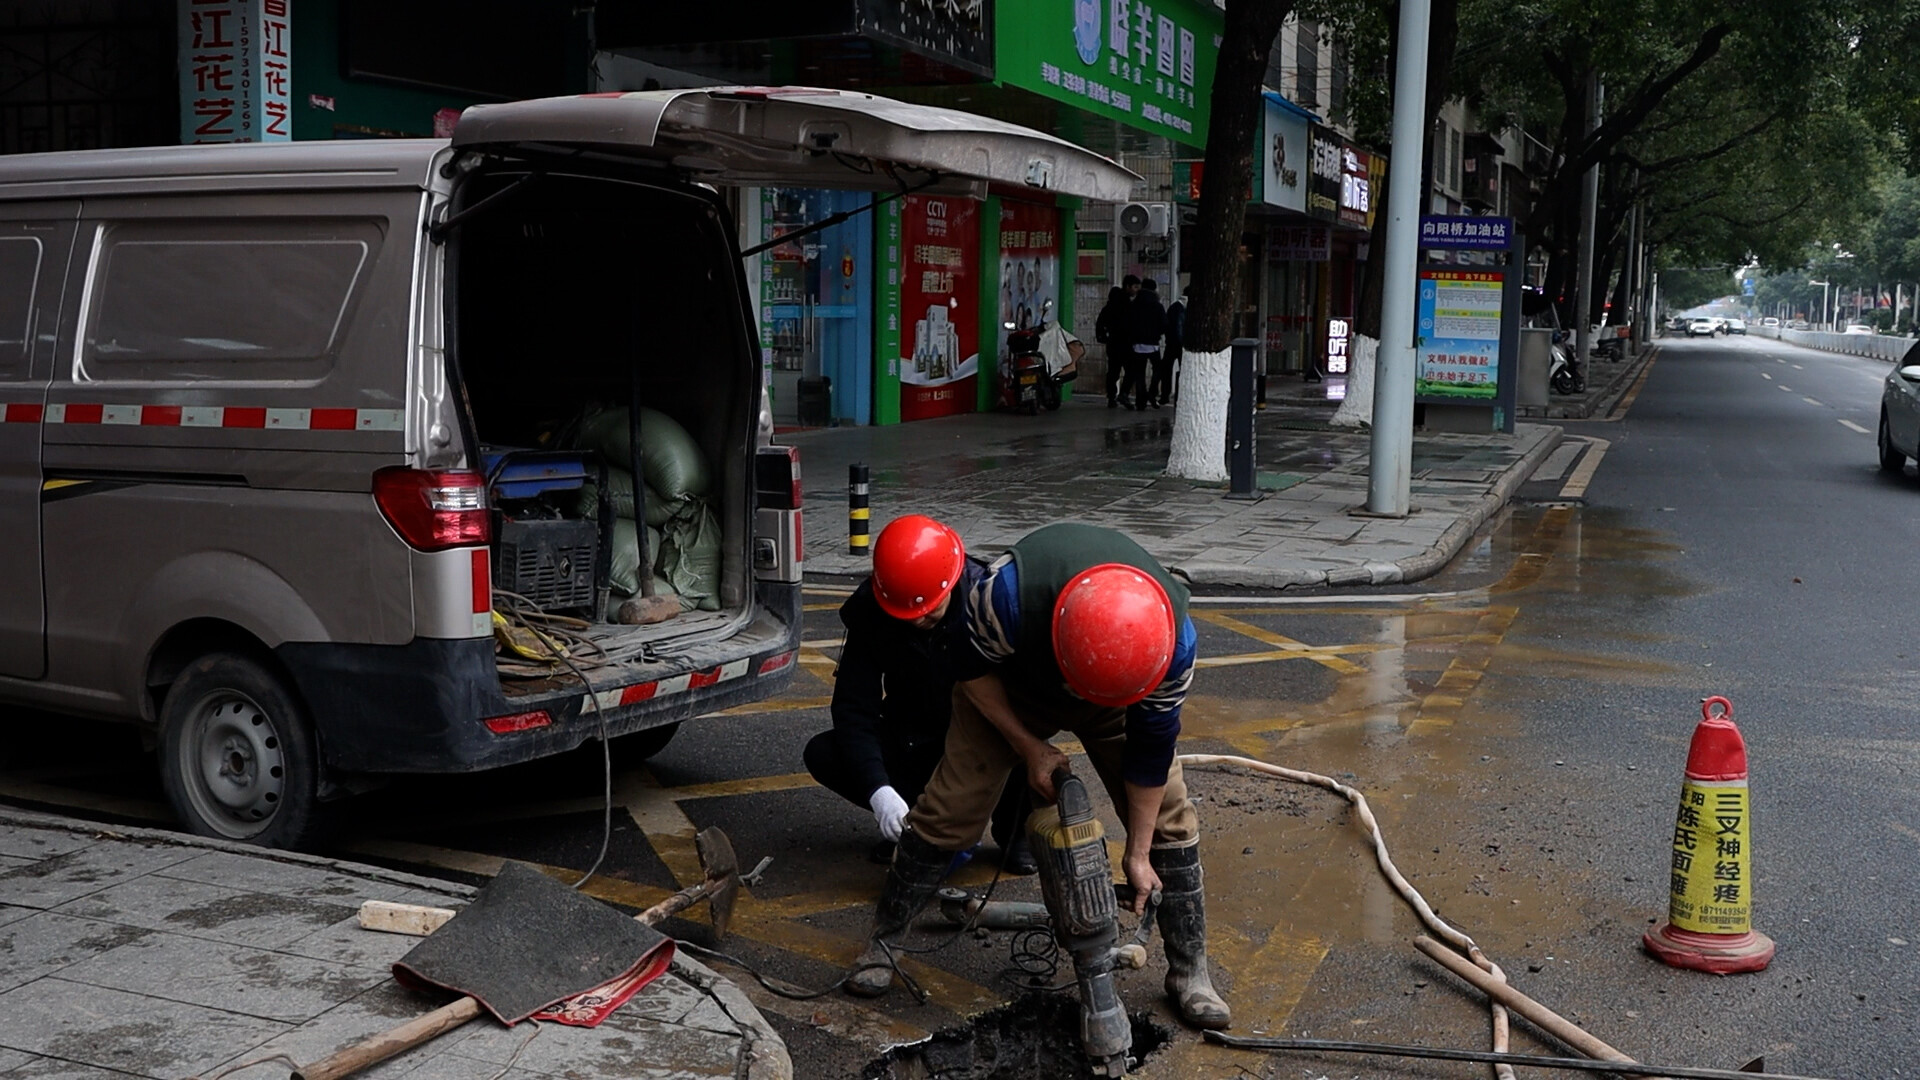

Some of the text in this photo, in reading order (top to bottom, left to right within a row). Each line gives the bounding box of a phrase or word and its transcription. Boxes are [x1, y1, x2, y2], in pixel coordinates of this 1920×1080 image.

[191, 0, 235, 135] 江花艺
[926, 200, 948, 218] CCTV
[1423, 221, 1506, 238] 向阳桥加油站
[1327, 319, 1349, 374] 助听器
[1427, 353, 1489, 366] 文明从我做起
[1425, 370, 1489, 382] 卫生始于足下
[1713, 793, 1744, 904] 三叉神经疼
